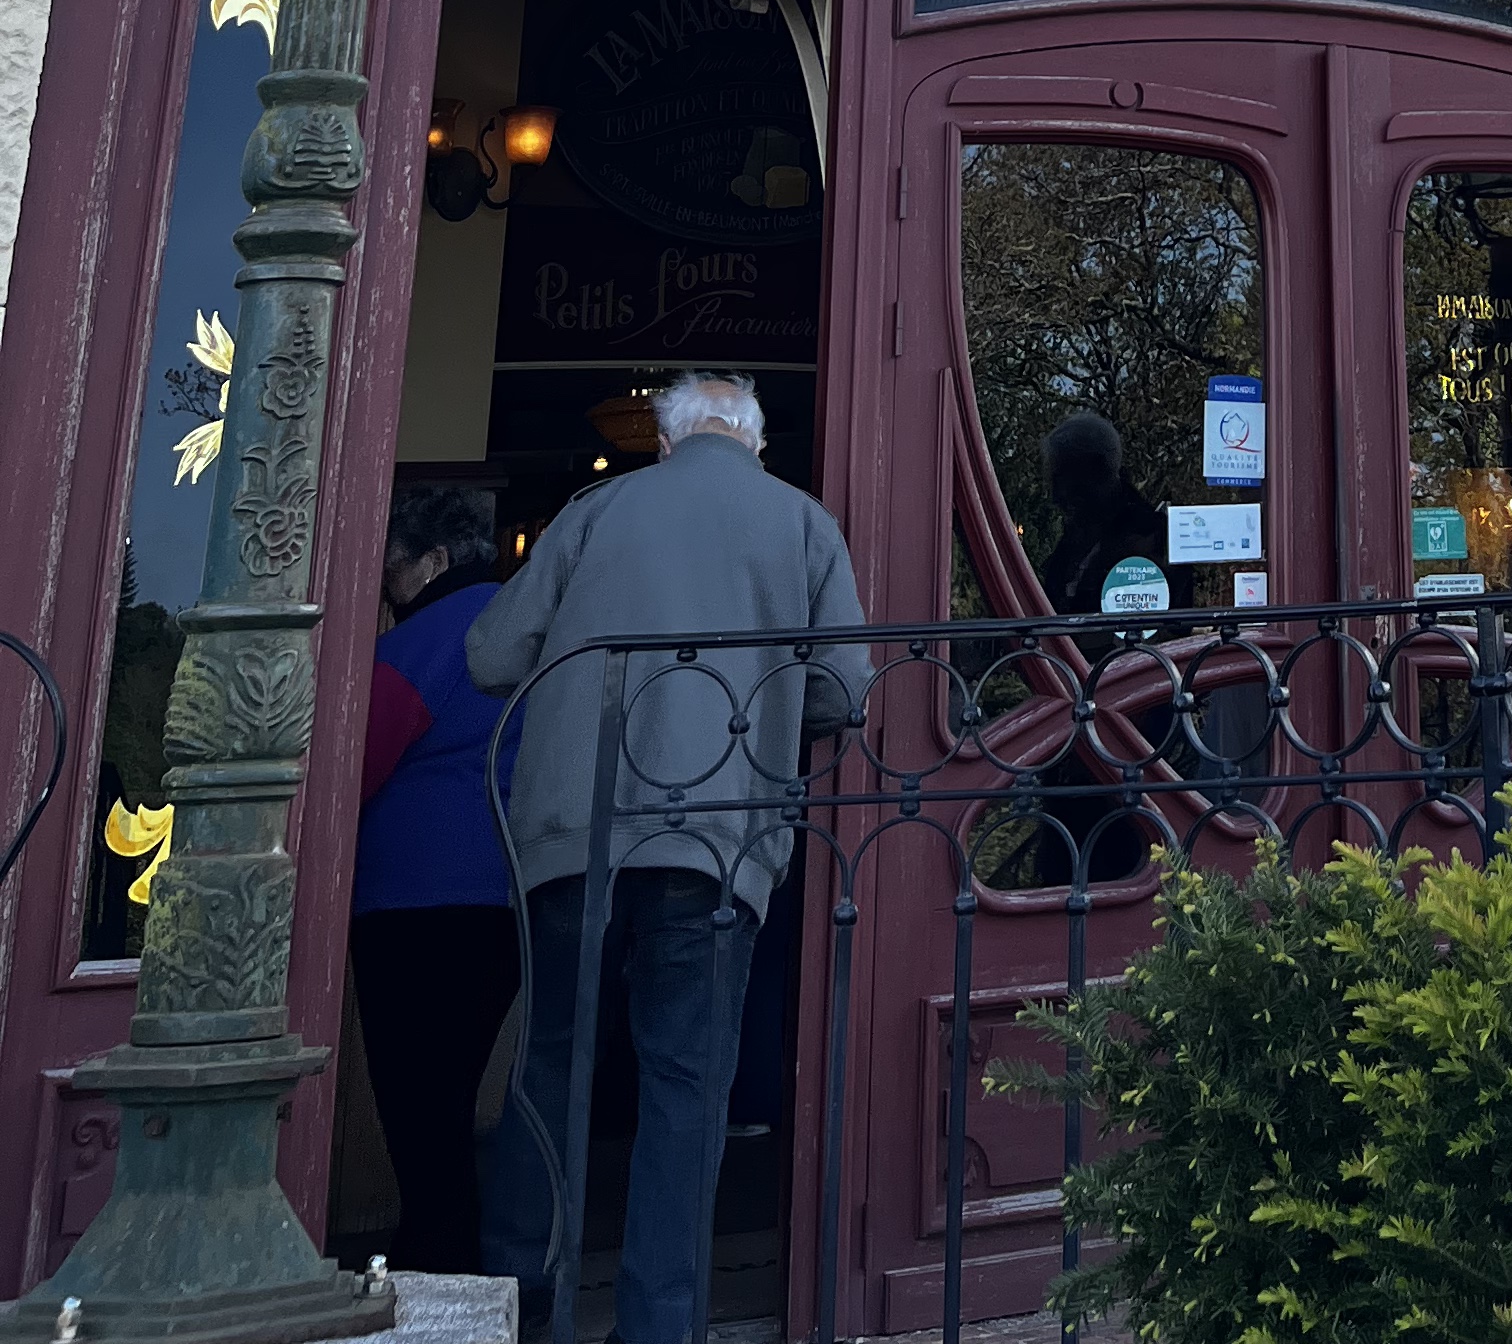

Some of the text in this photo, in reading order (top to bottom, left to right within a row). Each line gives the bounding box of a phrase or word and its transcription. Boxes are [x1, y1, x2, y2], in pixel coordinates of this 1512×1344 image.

[582, 29, 643, 96] LA
[604, 94, 709, 139] TRADITION
[718, 89, 741, 112] ET
[1450, 346, 1488, 372] EST
[1214, 384, 1256, 395] NORMANDIE
[1437, 372, 1494, 403] TOUS
[1211, 461, 1258, 470] TOURISME
